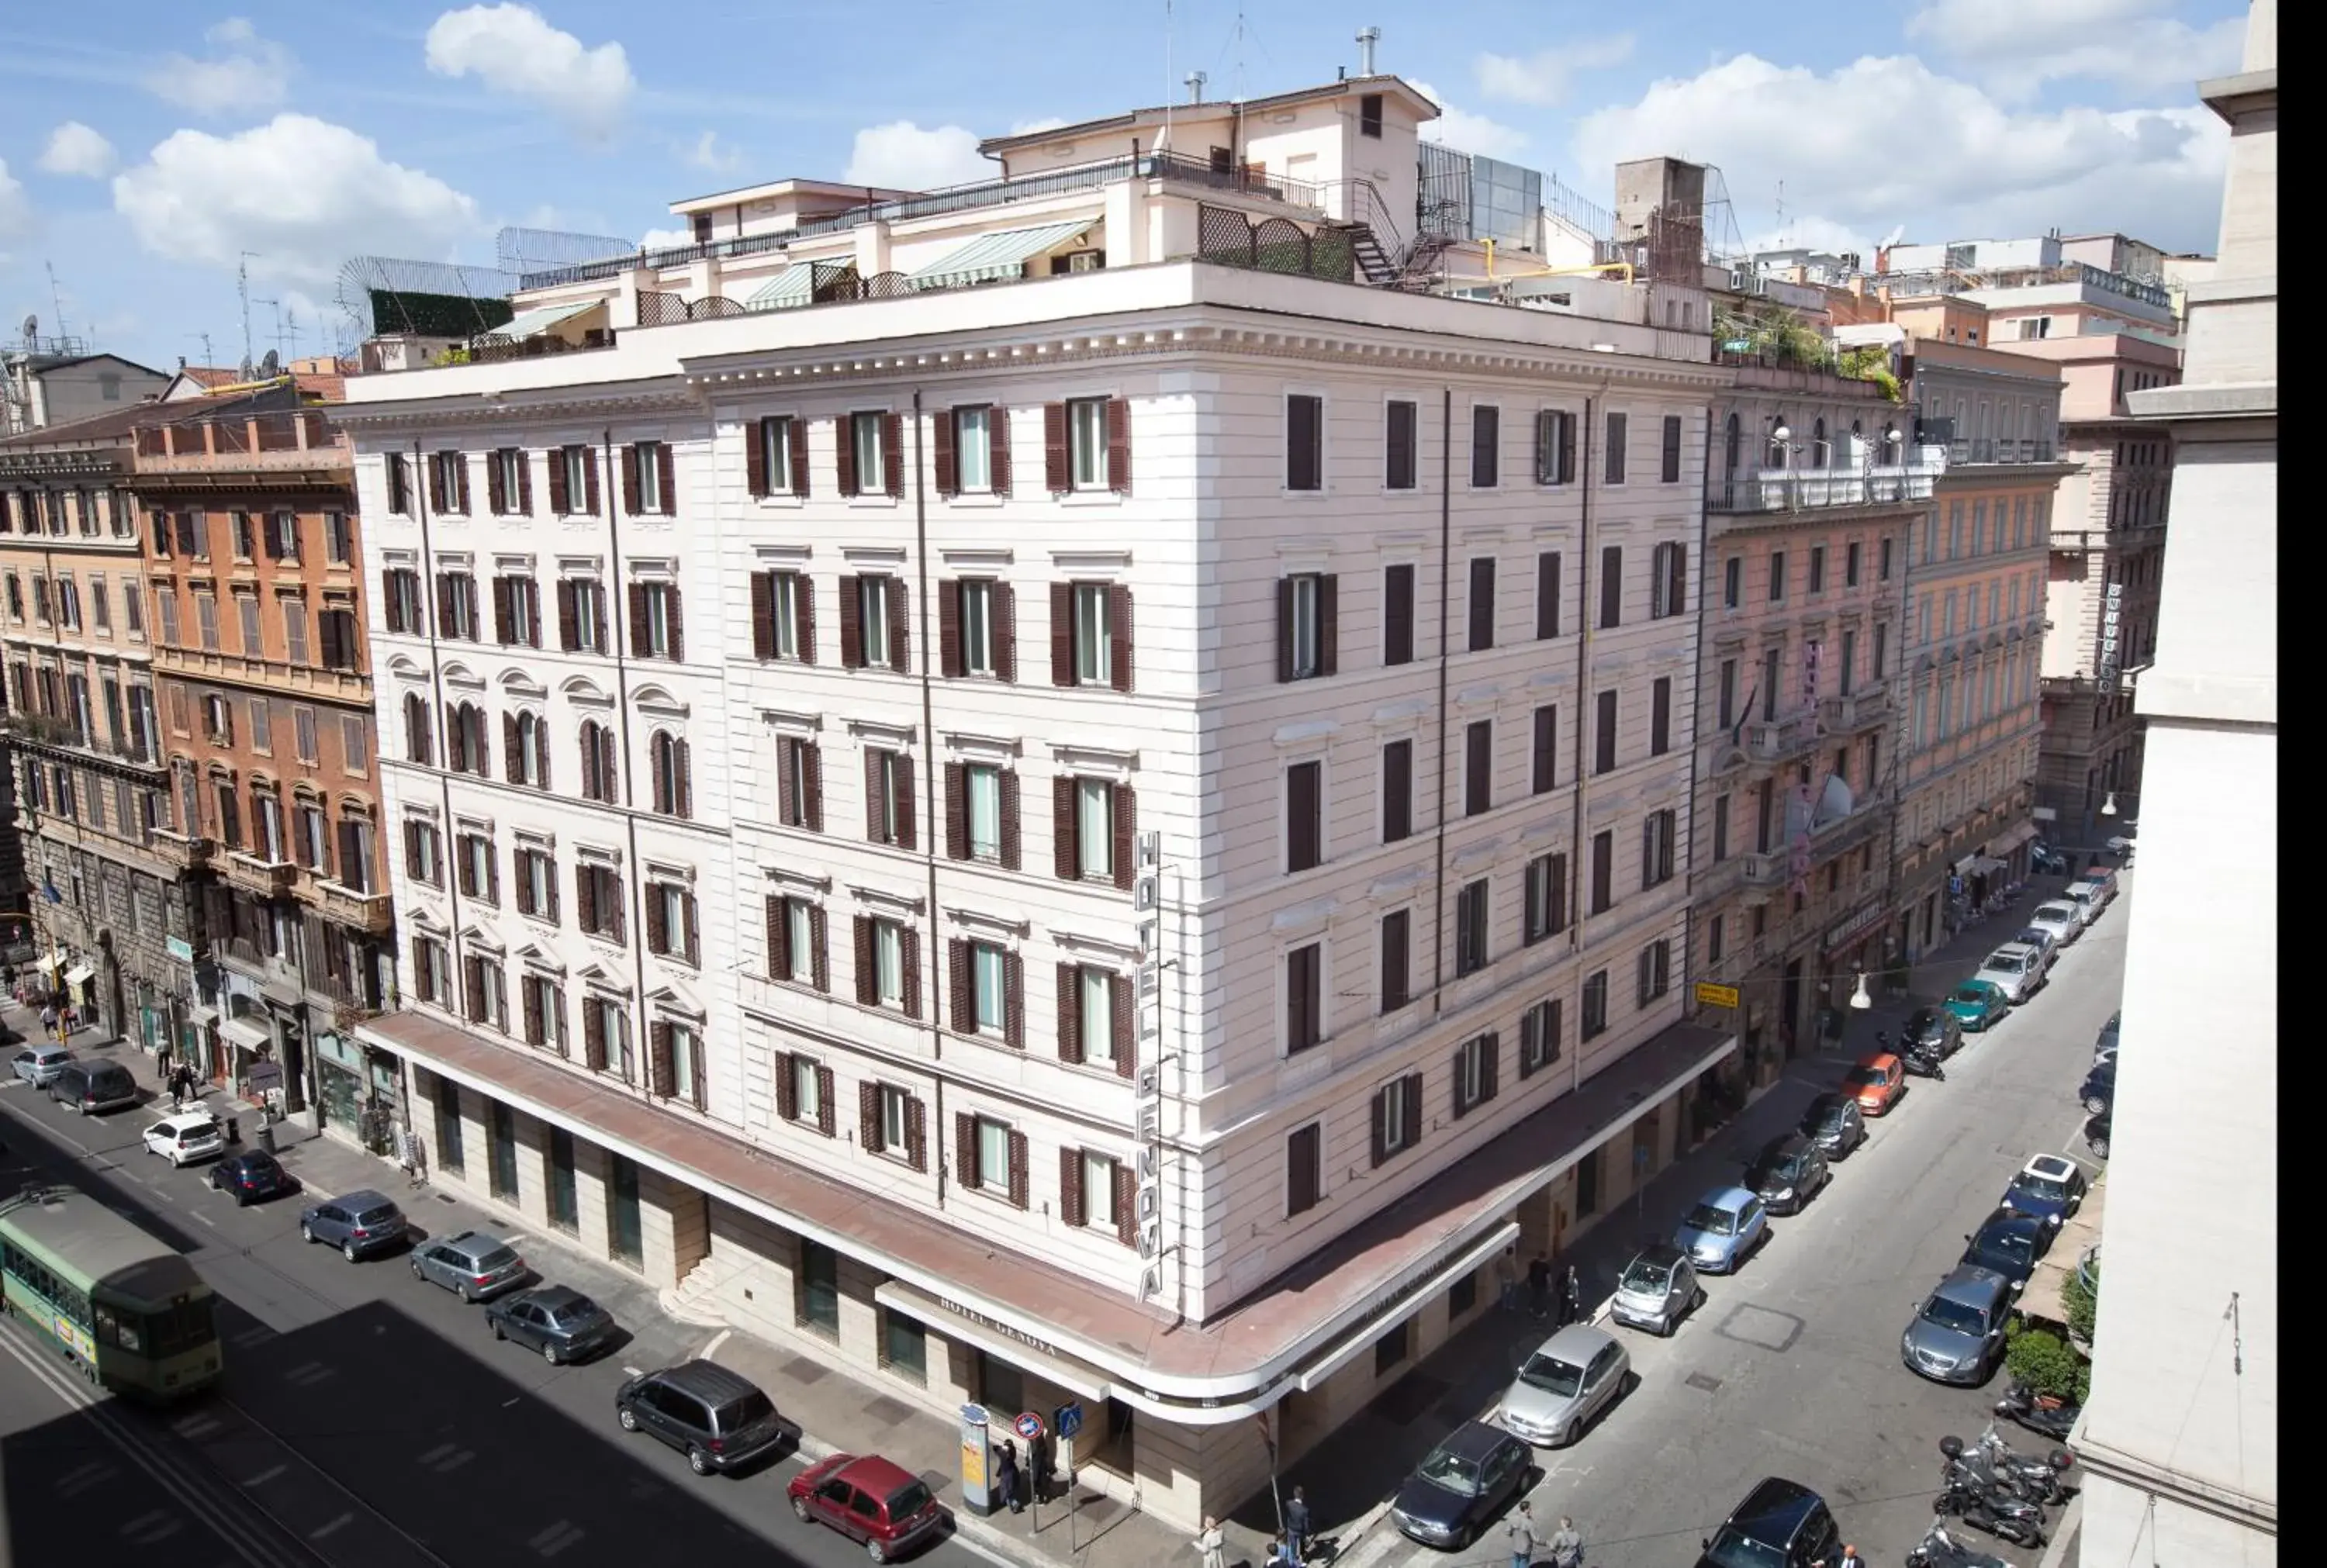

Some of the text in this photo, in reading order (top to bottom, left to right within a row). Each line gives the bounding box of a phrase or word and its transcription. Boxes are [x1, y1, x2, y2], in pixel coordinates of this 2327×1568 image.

[1136, 831, 1160, 1304] HOTEL GENOVA
[940, 1297, 988, 1327] HOTEL
